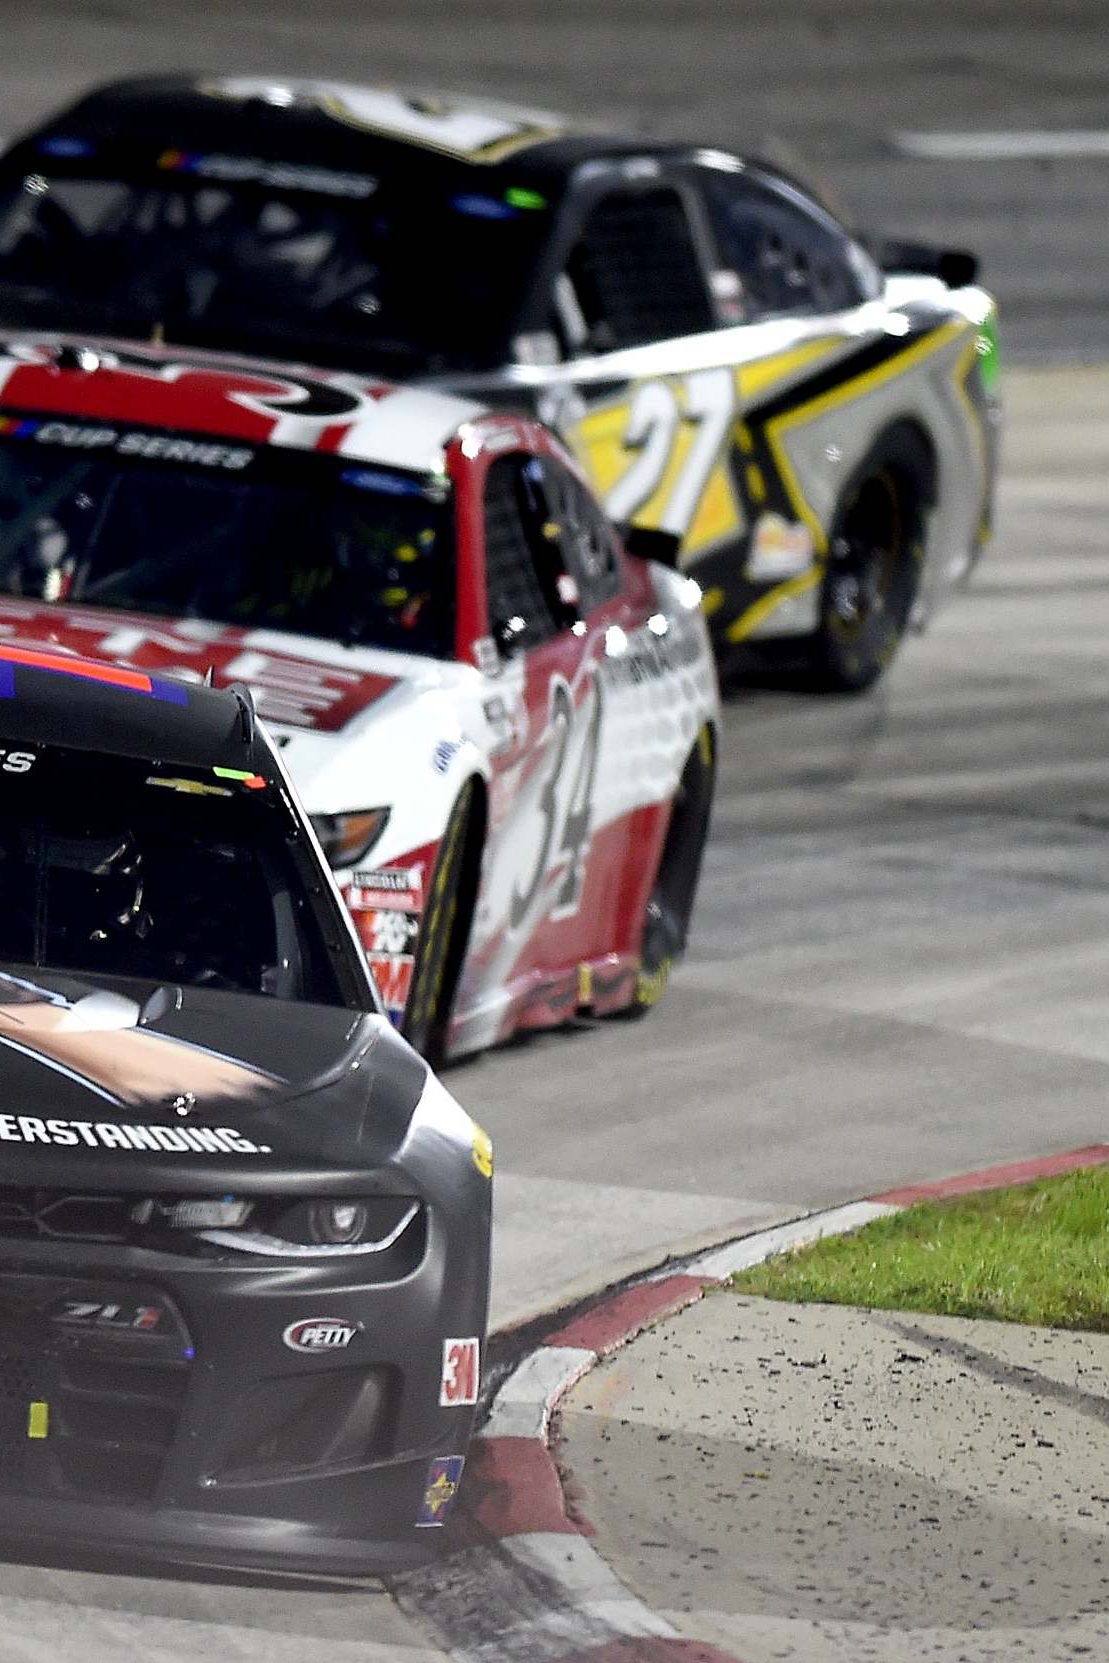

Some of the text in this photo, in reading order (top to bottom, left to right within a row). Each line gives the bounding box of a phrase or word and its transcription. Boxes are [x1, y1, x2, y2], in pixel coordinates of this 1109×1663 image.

[35, 421, 254, 469] CUP SERIES
[602, 366, 734, 536] 27
[299, 1327, 357, 1348] PETTY
